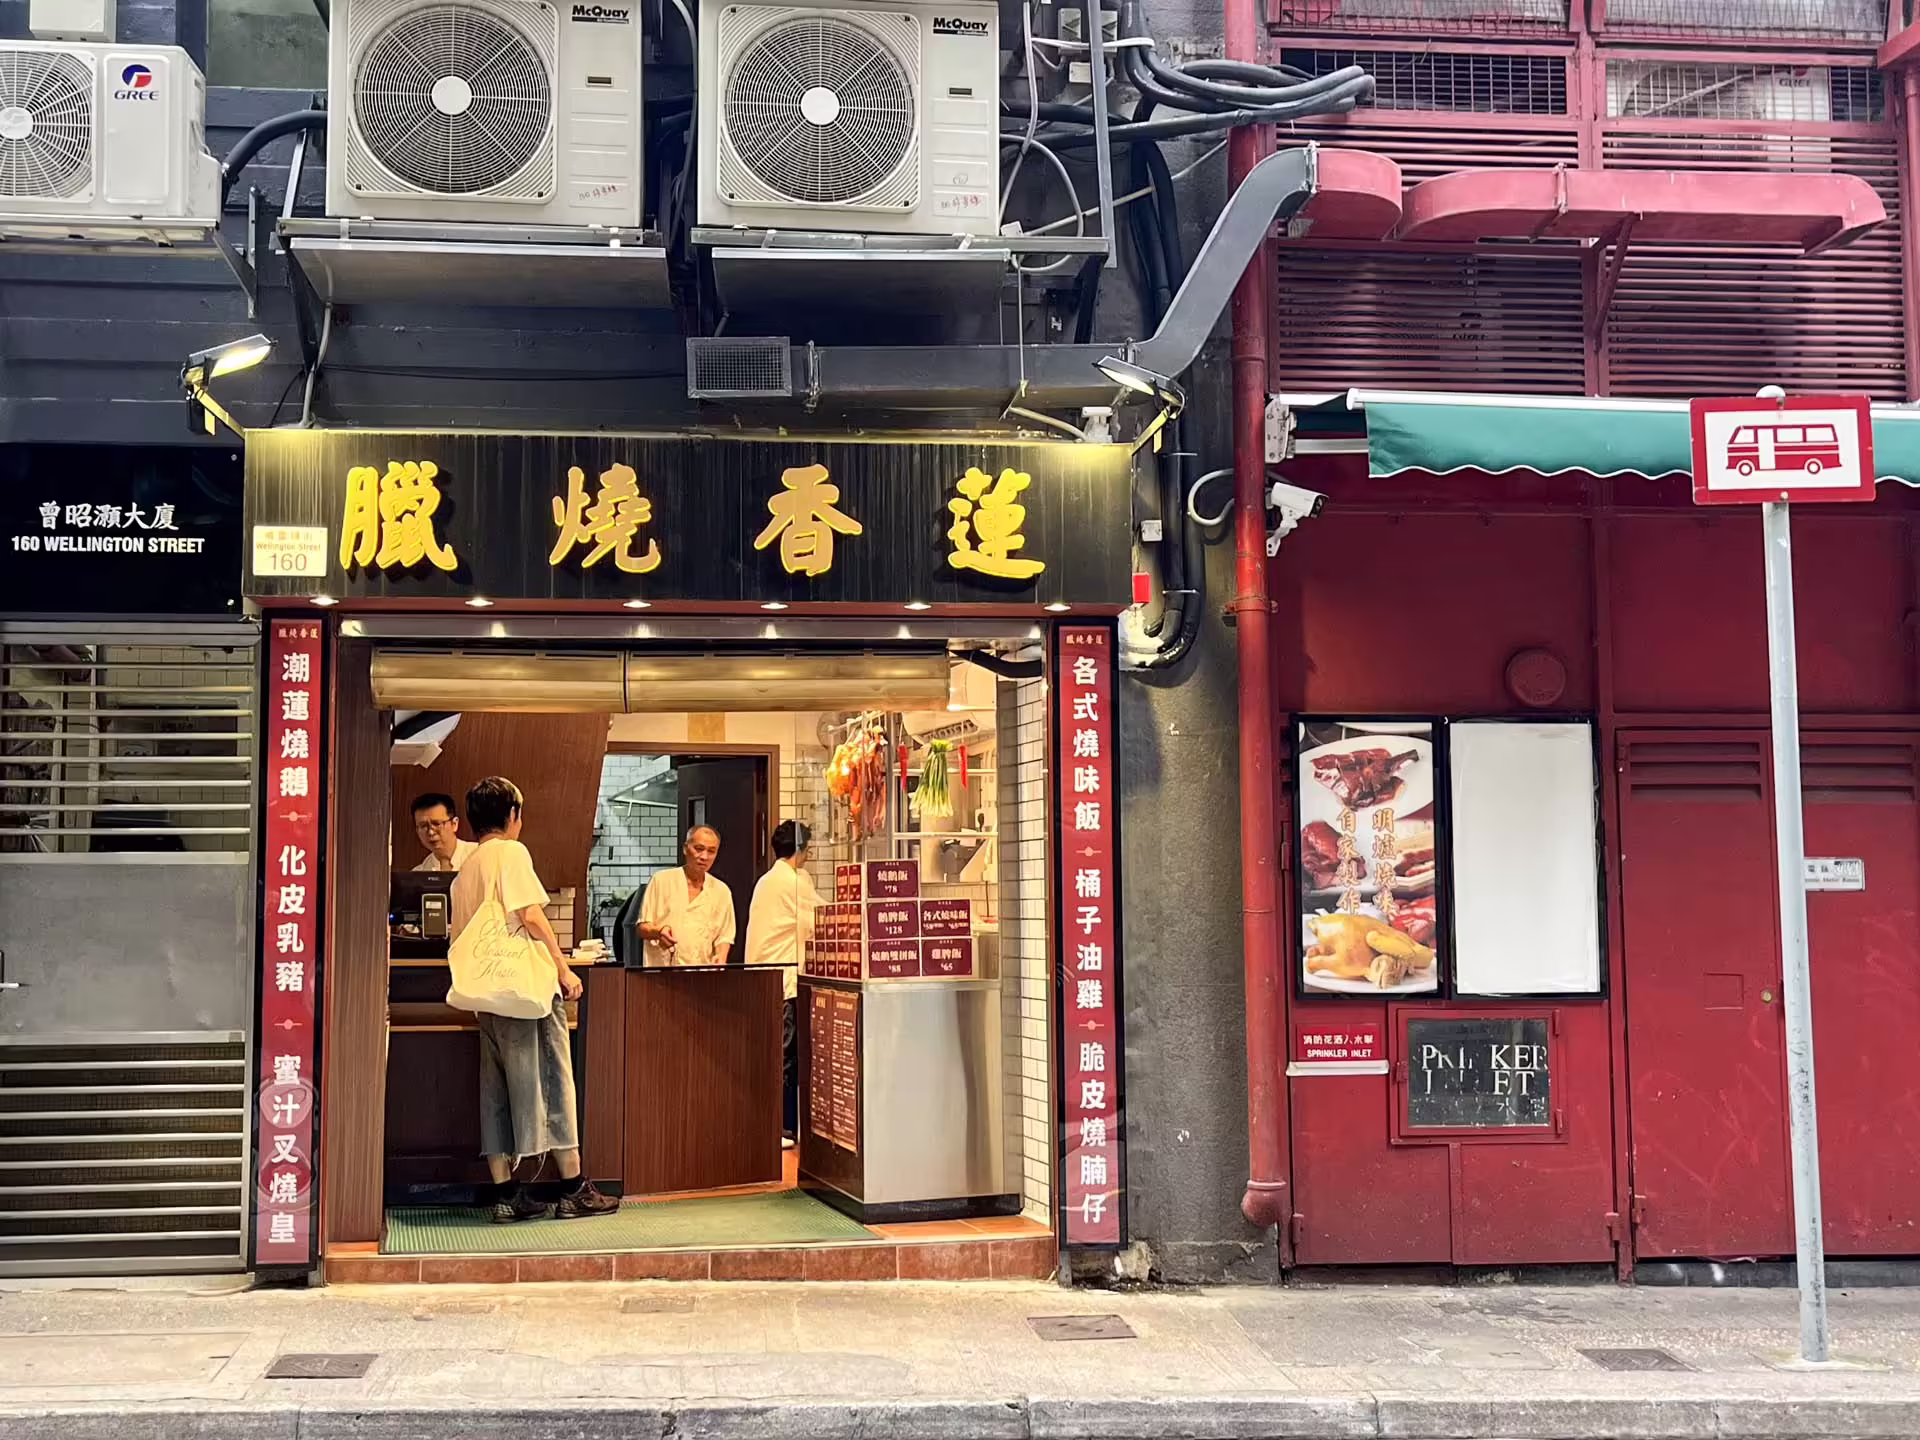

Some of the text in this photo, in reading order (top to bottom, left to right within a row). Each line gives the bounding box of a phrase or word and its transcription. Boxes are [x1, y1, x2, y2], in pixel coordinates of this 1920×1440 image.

[572, 5, 629, 18] McQuay
[933, 17, 988, 31] McQuay
[114, 90, 160, 100] GREE
[11, 536, 205, 553] 160 WELLINGTON STREET
[269, 553, 307, 571] 160
[280, 652, 310, 797] 潮蓮燒鵝
[1072, 656, 1101, 831] 各式燒味飯
[275, 845, 307, 992] 化皮乳豬
[1075, 868, 1104, 1010] 桶子油雞
[1307, 1048, 1372, 1058] SPRINKLER INLET
[268, 1054, 301, 1243] 蜜汁叉燒皇
[1079, 1042, 1107, 1224] 脆皮燒腩仔
